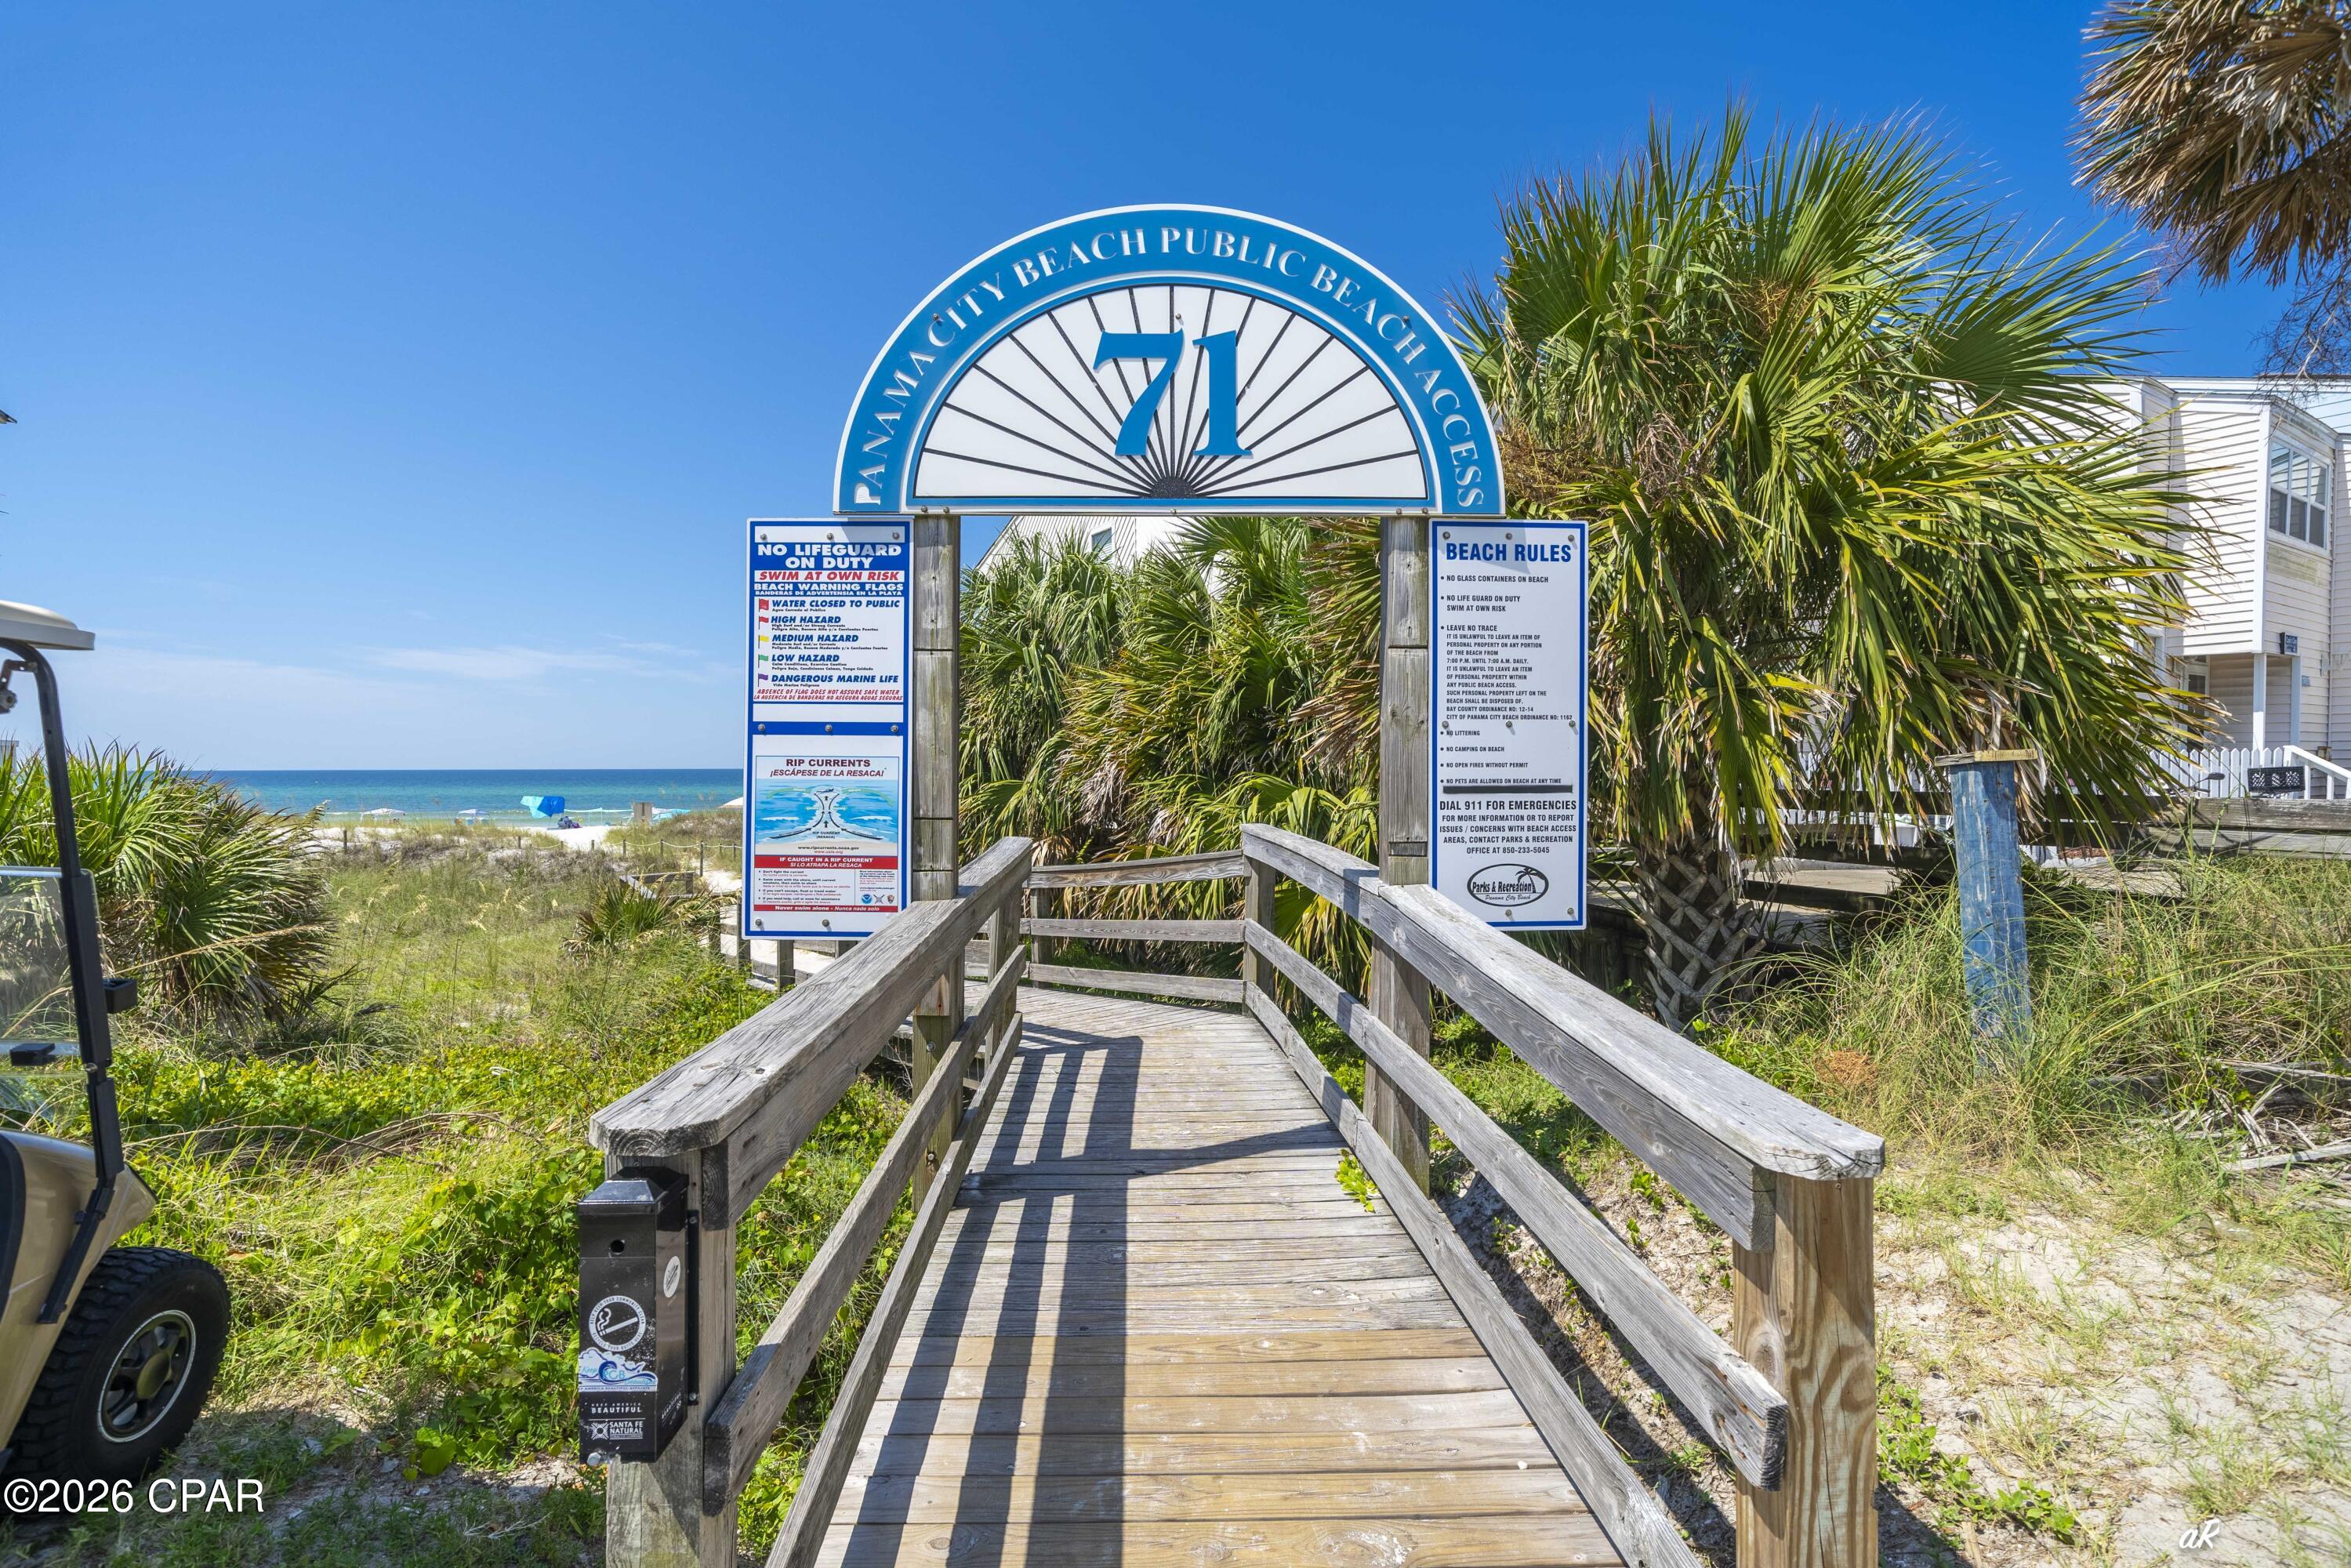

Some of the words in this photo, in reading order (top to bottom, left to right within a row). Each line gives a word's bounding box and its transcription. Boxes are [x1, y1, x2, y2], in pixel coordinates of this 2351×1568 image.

[854, 350, 935, 505] PANAMA
[927, 270, 1006, 348] CITY
[1012, 229, 1146, 289] BEACH
[1160, 227, 1307, 279] PUBLIC
[1310, 263, 1428, 365] BEACH
[1415, 368, 1485, 508] ACCESS
[1093, 328, 1253, 459] 71
[758, 544, 787, 555] NO
[795, 545, 902, 556] LIFEGUARD
[1446, 543, 1506, 561] BEACH
[1515, 544, 1571, 562] RULES
[785, 557, 815, 568] ON
[823, 557, 873, 568] DUTY
[759, 572, 799, 580] SWIM
[804, 572, 822, 580] AT
[827, 572, 862, 580] OWN
[868, 572, 899, 580] RISK
[1440, 801, 1461, 810] DIAL
[1465, 801, 1481, 810] 911
[1486, 800, 1504, 810] FOR
[1509, 800, 1576, 810] EMERGENCIES
[1472, 882, 1490, 892] Parks
[1491, 881, 1496, 892] &
[1498, 881, 1531, 892] Recreation
